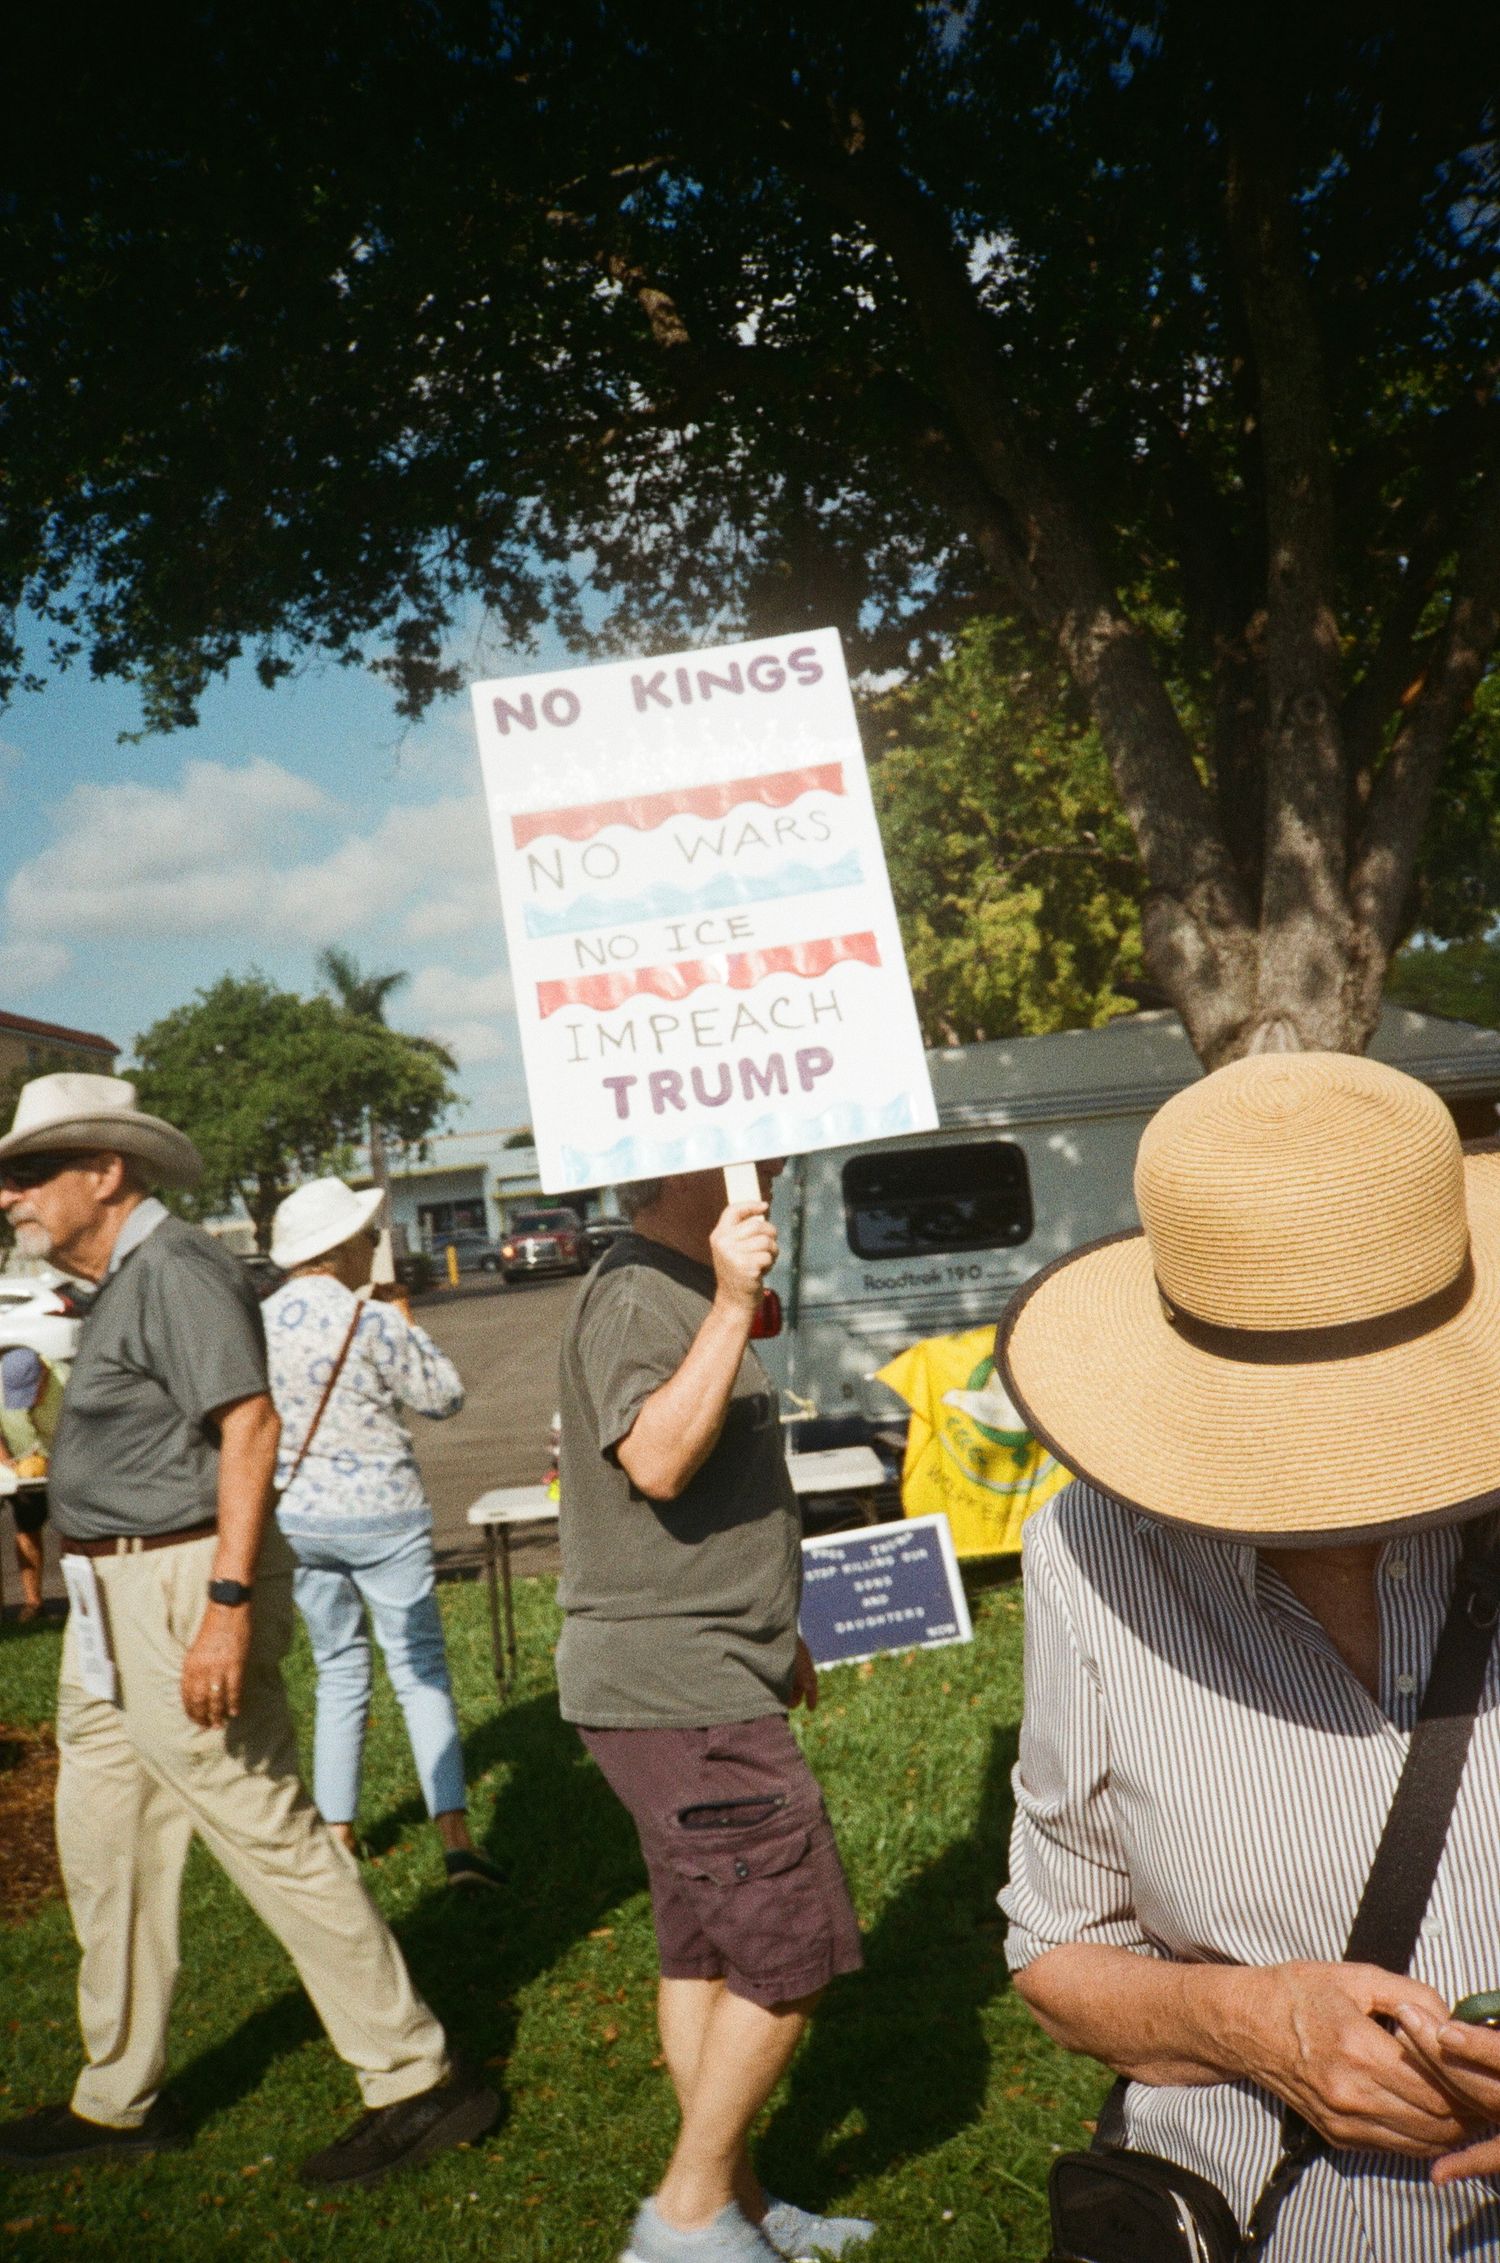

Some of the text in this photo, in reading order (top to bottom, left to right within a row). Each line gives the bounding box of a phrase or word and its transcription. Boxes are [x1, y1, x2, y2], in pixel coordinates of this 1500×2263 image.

[493, 646, 824, 735] NO KINGS
[528, 810, 831, 892] NO WARS
[574, 915, 754, 969] NO ICE
[565, 989, 843, 1063] IMPEACH
[602, 1046, 834, 1120] TRUMP
